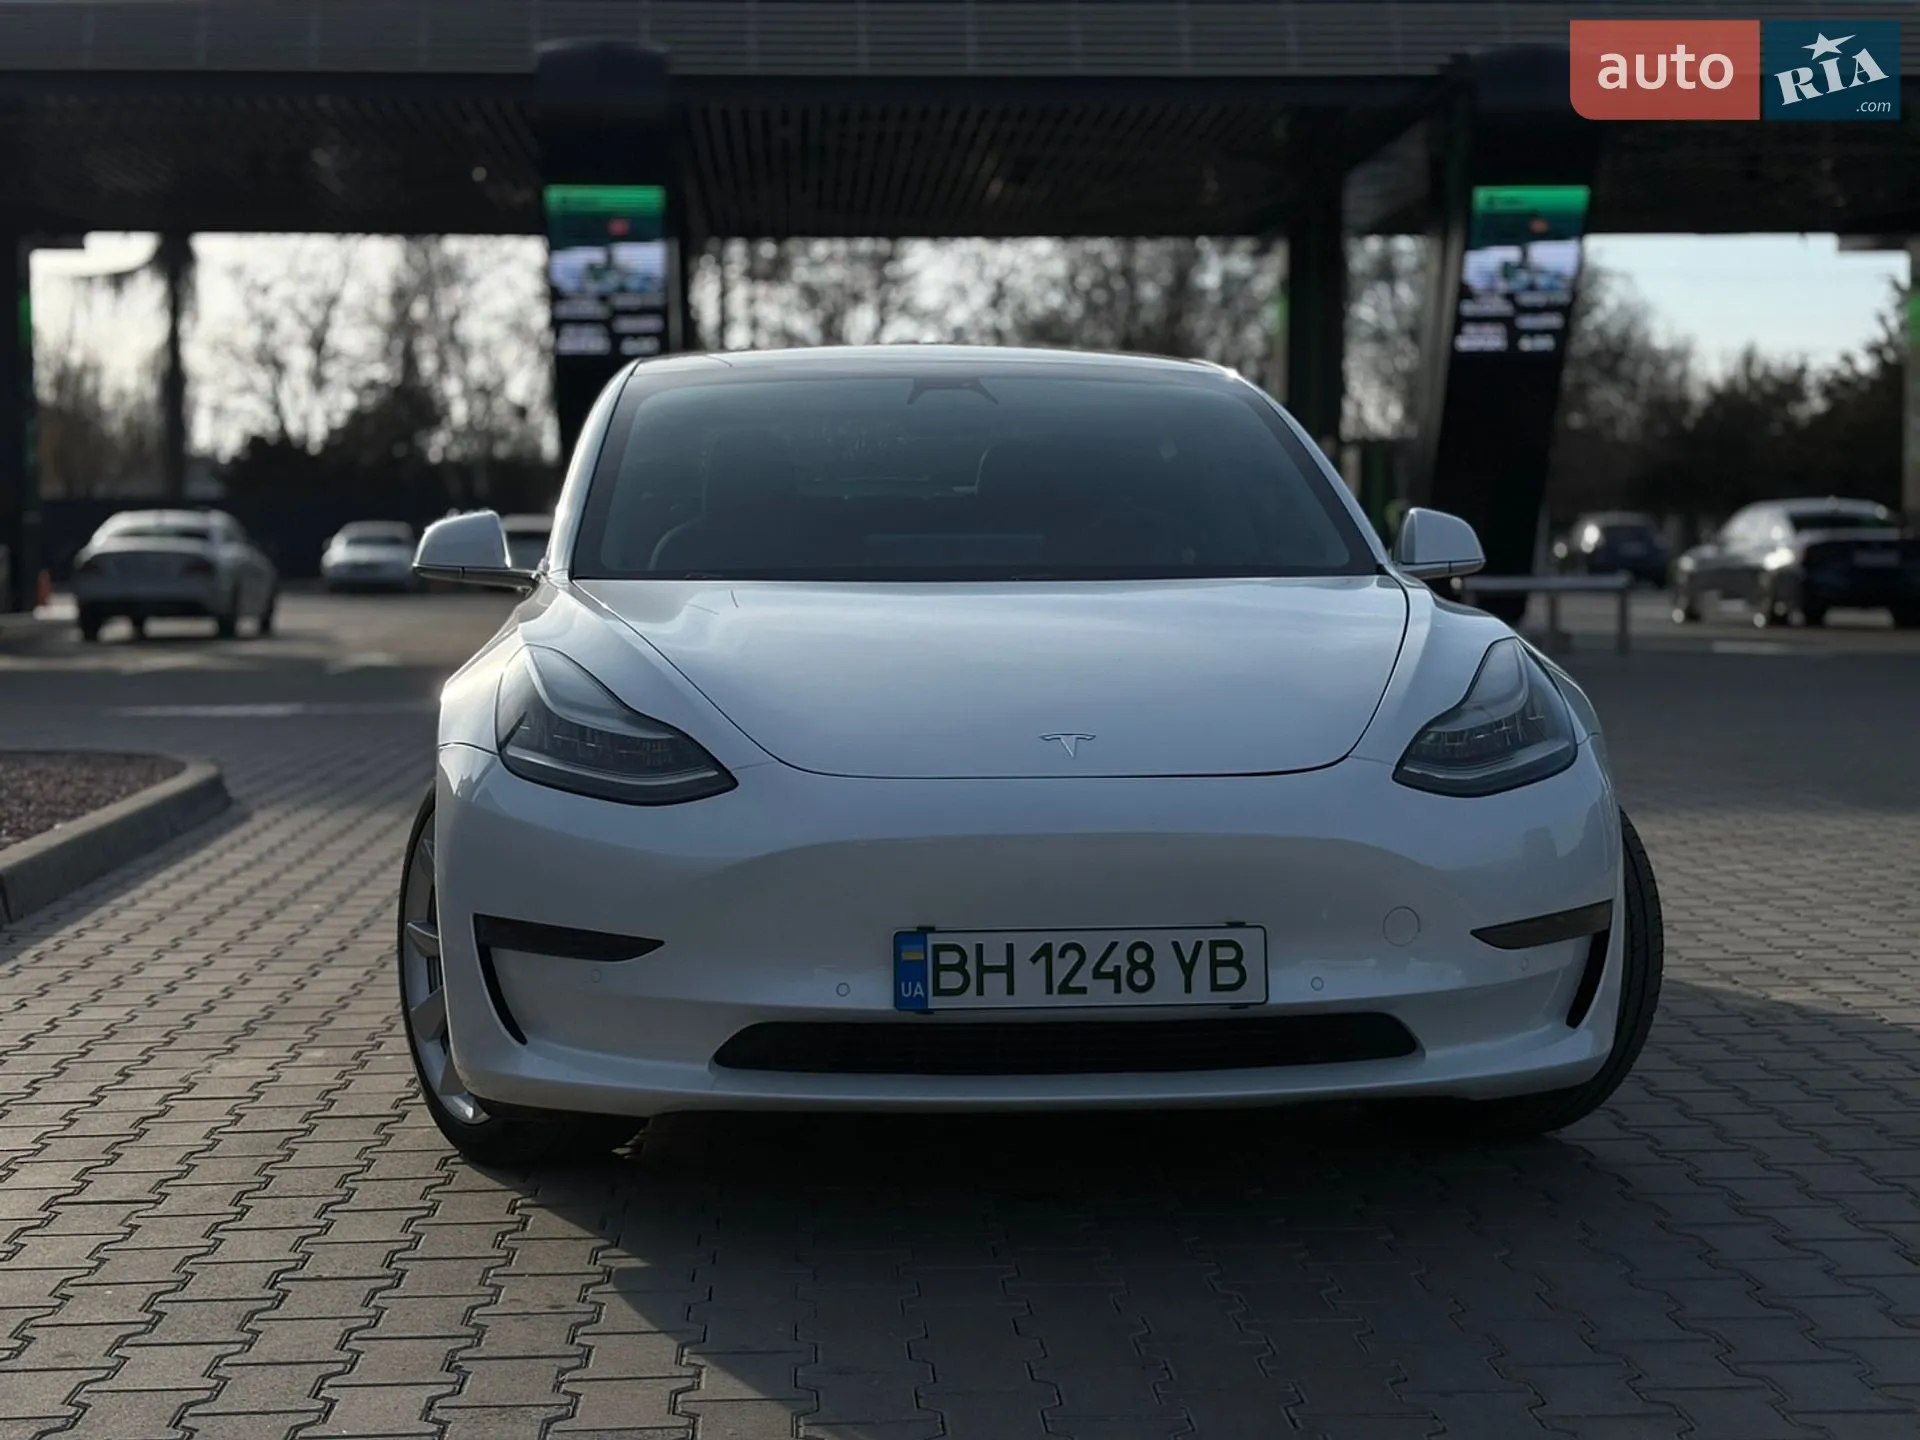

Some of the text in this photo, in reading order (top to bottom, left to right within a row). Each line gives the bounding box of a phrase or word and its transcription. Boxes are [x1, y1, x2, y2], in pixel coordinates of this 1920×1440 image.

[931, 939, 1247, 997] BH 1248 YB
[901, 981, 925, 998] UA
